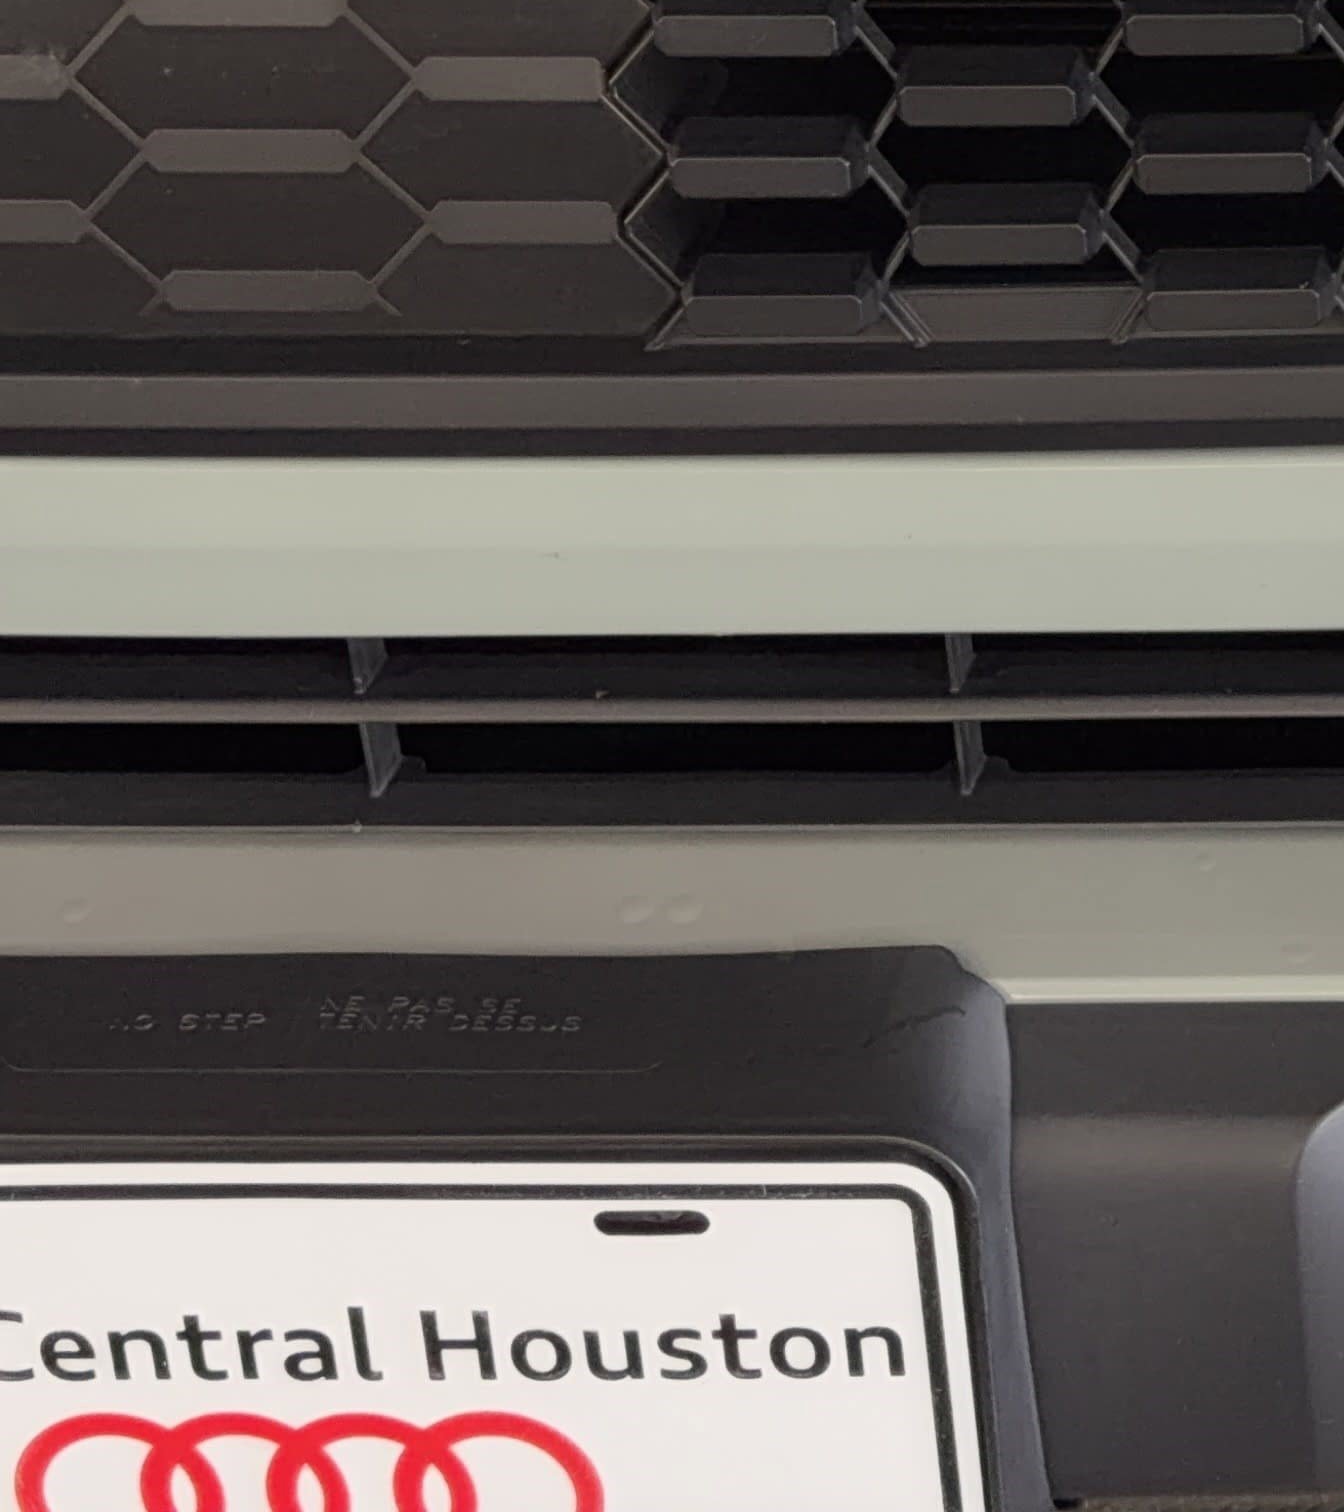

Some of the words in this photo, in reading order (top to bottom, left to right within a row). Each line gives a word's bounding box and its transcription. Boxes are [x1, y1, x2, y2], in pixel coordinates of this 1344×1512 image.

[387, 995, 455, 1014] PAS
[480, 997, 522, 1015] SE
[178, 1013, 267, 1032] STEP
[419, 1309, 906, 1382] Houston
